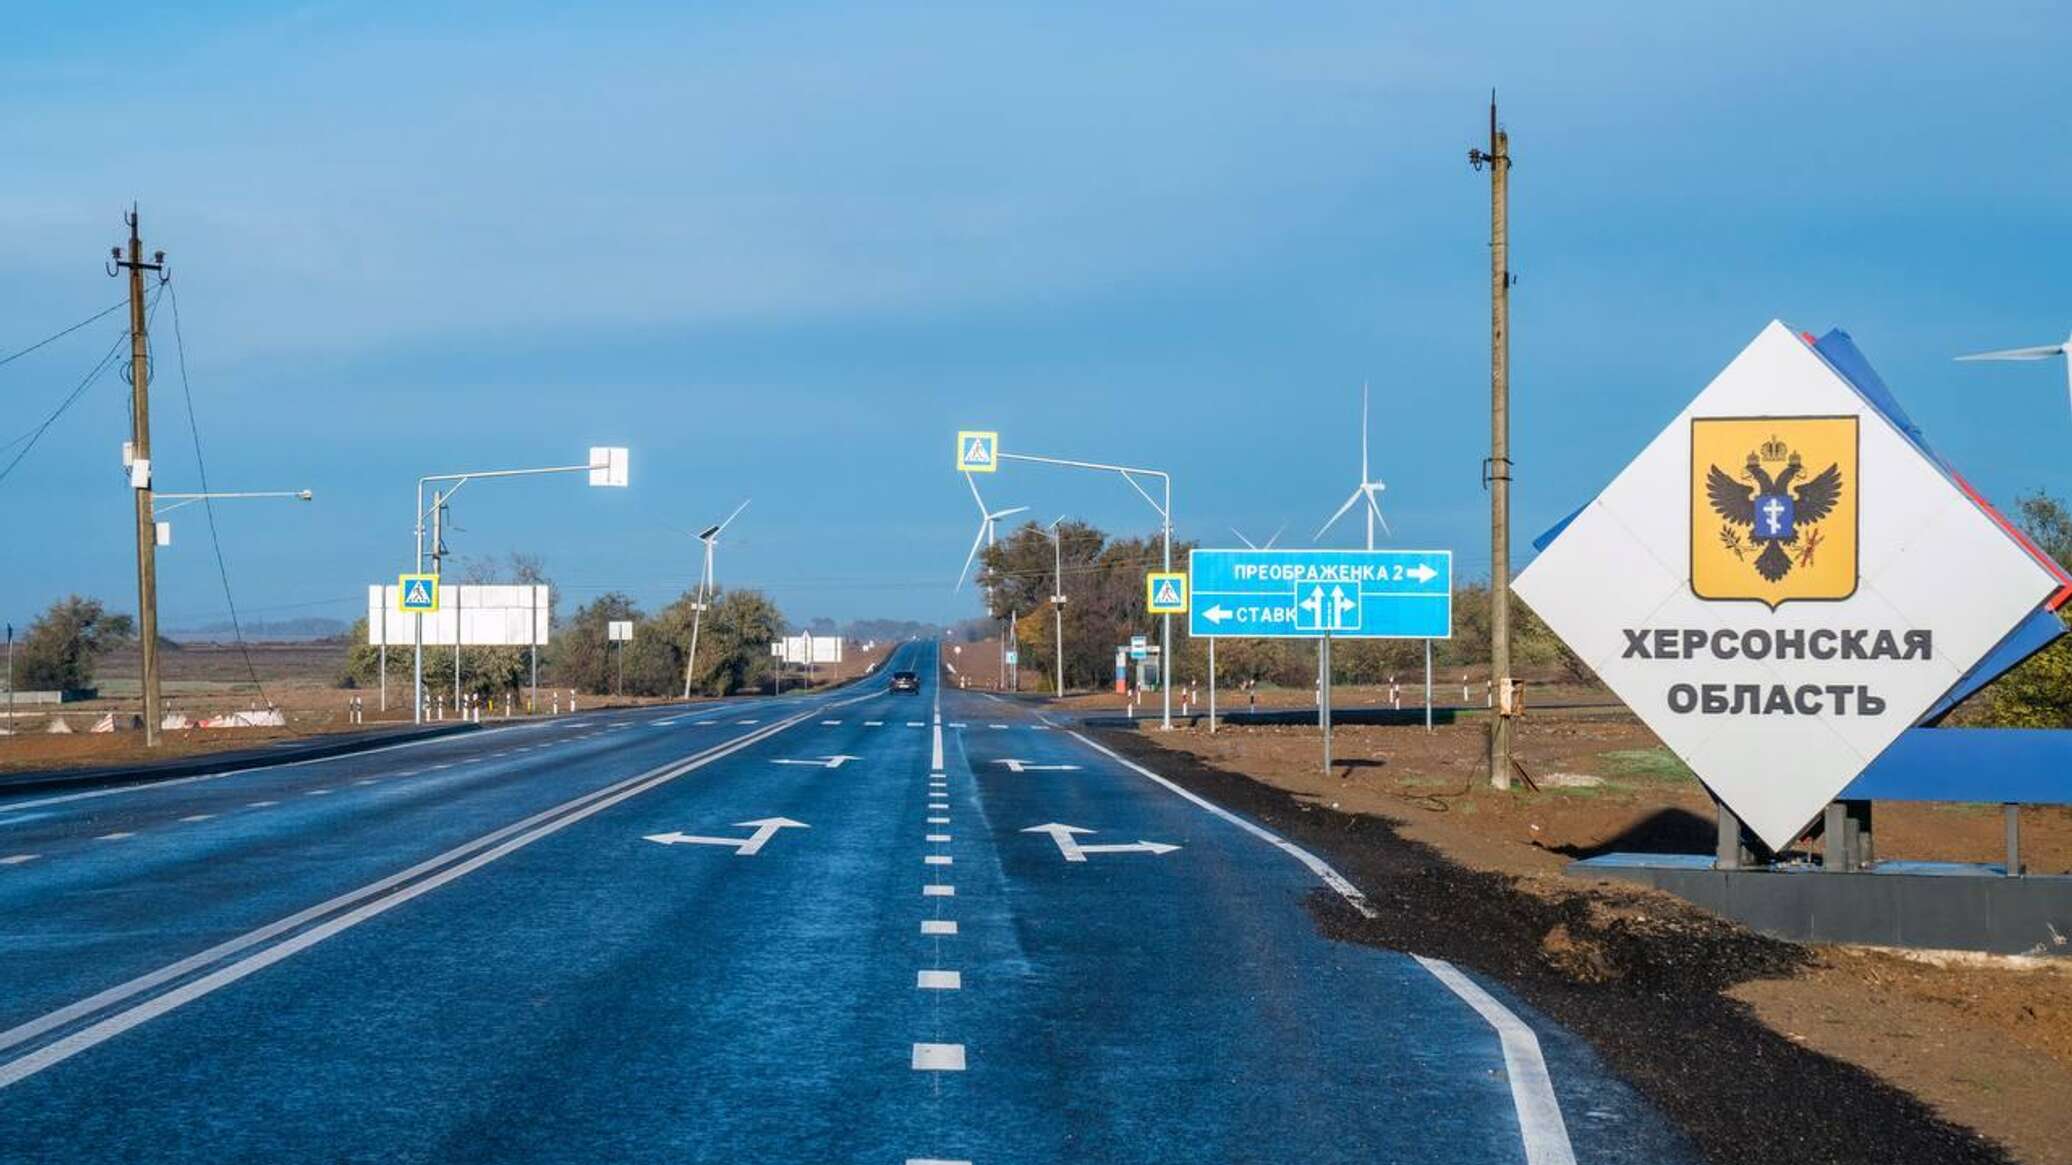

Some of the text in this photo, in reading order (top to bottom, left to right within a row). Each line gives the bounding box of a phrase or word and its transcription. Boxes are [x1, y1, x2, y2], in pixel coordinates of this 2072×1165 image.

[1234, 564, 1405, 581] ПРЕОБРАЖЕНКА 2
[1621, 629, 1933, 660] ХЕРСОНСКАЯ
[1667, 684, 1887, 716] ОБЛАСТЬ
